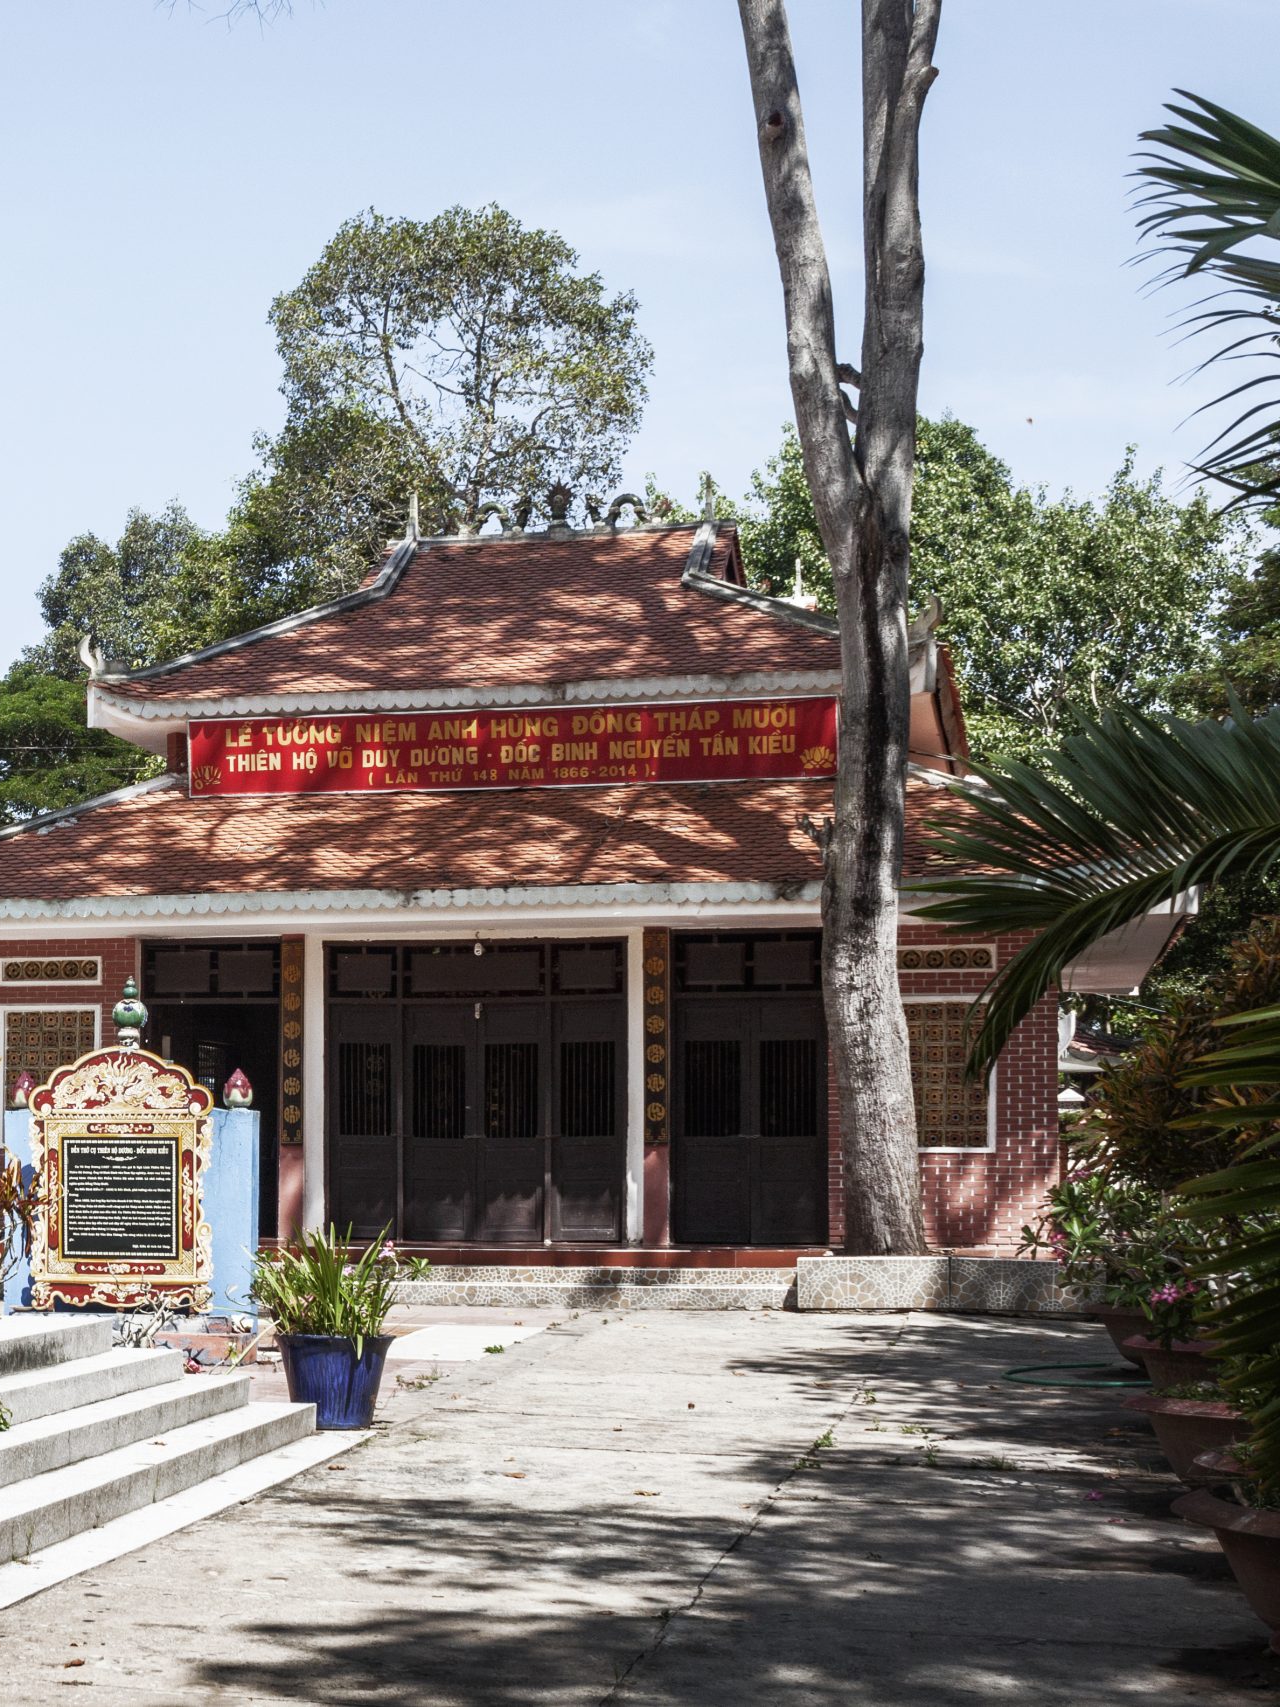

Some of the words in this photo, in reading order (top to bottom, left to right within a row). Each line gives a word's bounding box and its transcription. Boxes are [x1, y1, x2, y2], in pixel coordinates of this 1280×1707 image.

[225, 720, 253, 747] LỄ
[262, 718, 342, 746] TƯỞNG
[356, 719, 417, 745] NIỆM
[428, 719, 478, 741] ANH
[490, 714, 559, 739] HÙNG
[573, 708, 642, 735] ĐỒNG
[653, 706, 720, 733] THÁP
[732, 702, 796, 729] MƯỜI
[225, 749, 281, 772] THIÊN
[292, 747, 319, 774] HỘ
[326, 746, 353, 770] VÕ
[362, 749, 399, 768] DUY
[410, 745, 479, 767] DƯƠNG
[500, 738, 541, 764] ĐỐC
[551, 742, 598, 762] BINH
[609, 731, 690, 760] NGUYỄN
[699, 730, 739, 756] TẤN
[748, 729, 796, 756] KIỀU
[385, 769, 419, 785] LẦN
[429, 768, 463, 783] THỨ
[473, 768, 498, 782] 148
[508, 765, 545, 781] NĂM
